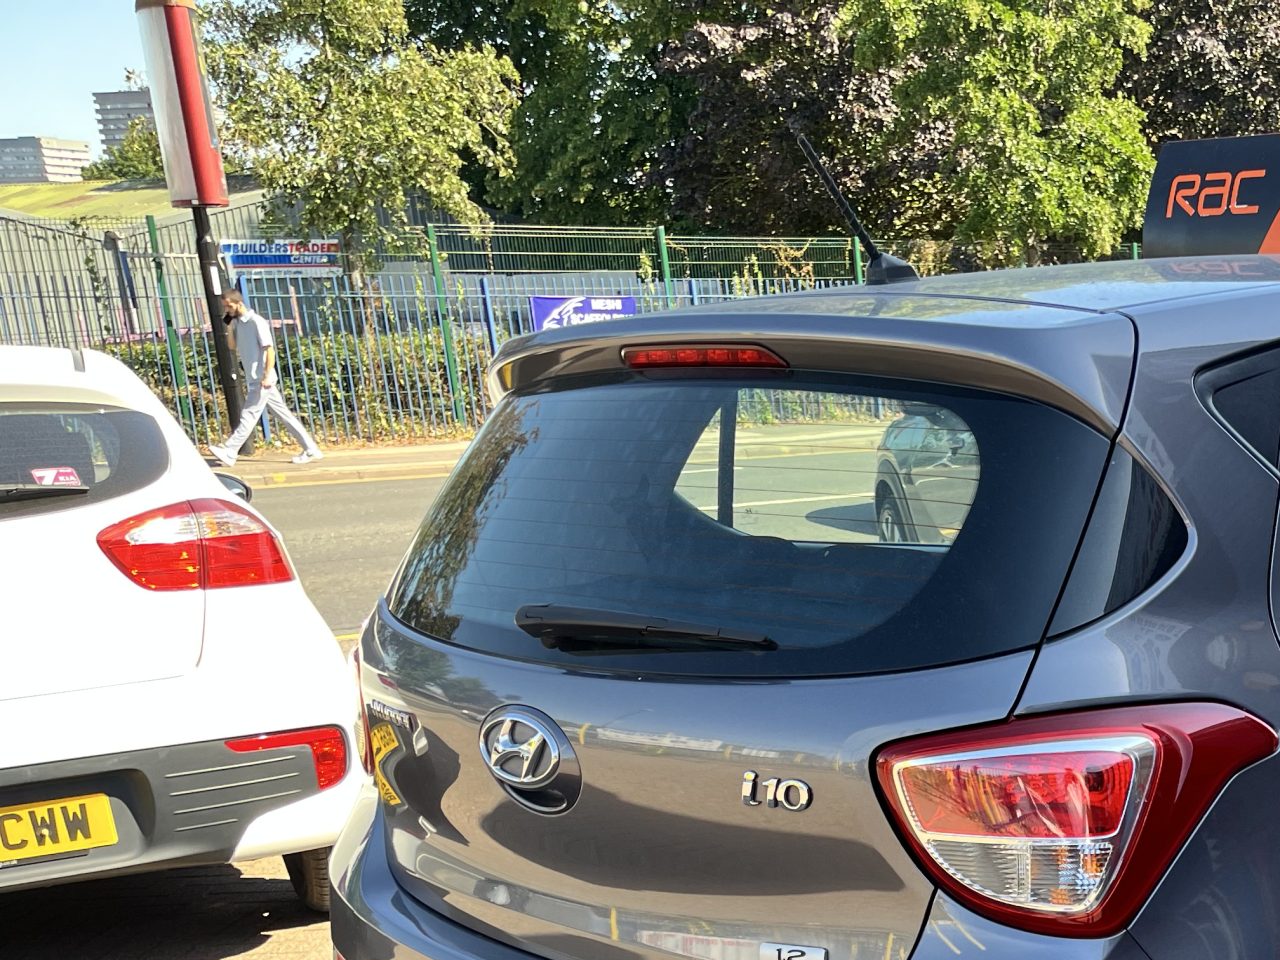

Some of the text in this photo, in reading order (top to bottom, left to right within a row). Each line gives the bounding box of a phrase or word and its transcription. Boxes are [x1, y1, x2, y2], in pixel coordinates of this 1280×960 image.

[570, 313, 635, 326] SCAFFO
[739, 769, 814, 813] i10
[0, 802, 92, 851] CWW
